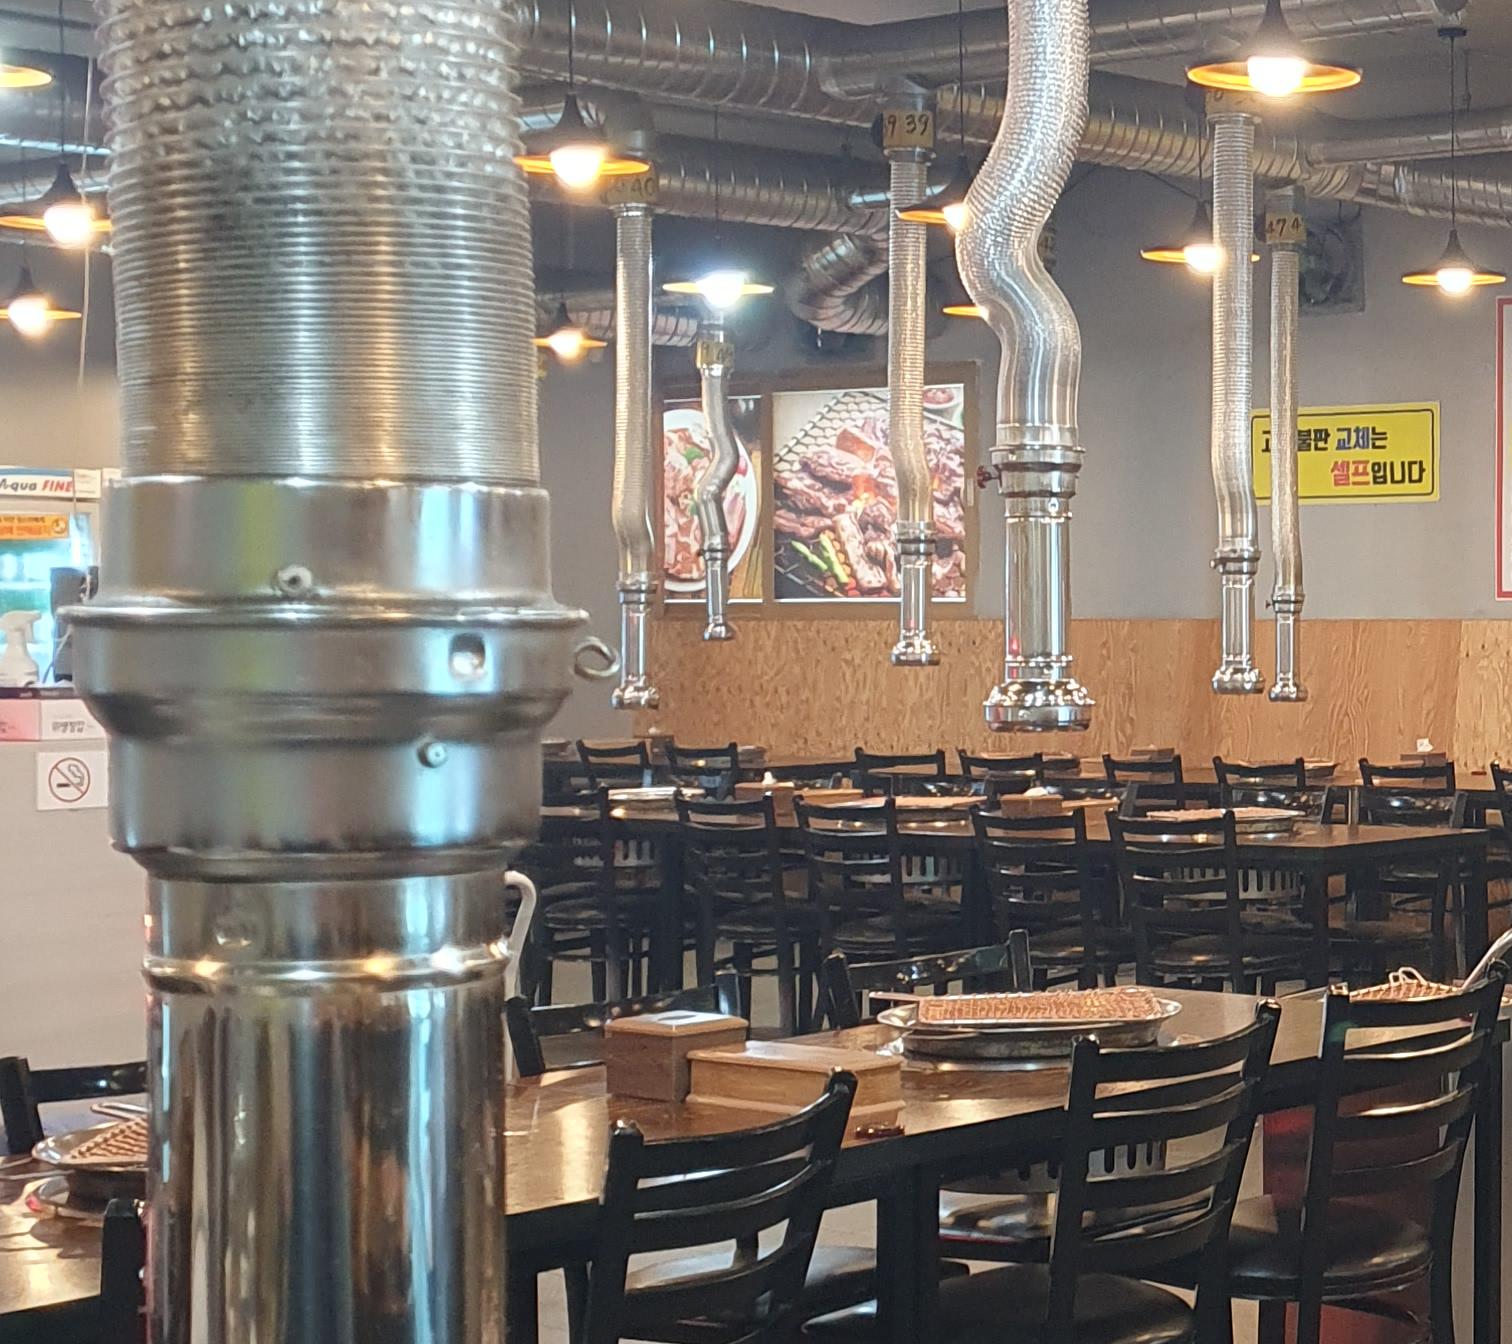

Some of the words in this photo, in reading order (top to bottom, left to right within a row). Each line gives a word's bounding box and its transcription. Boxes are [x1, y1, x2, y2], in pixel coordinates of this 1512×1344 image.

[905, 114, 929, 136] 39
[1335, 426, 1388, 451] 교체는
[1330, 459, 1426, 487] 셀프입니다
[42, 479, 74, 493] FINE
